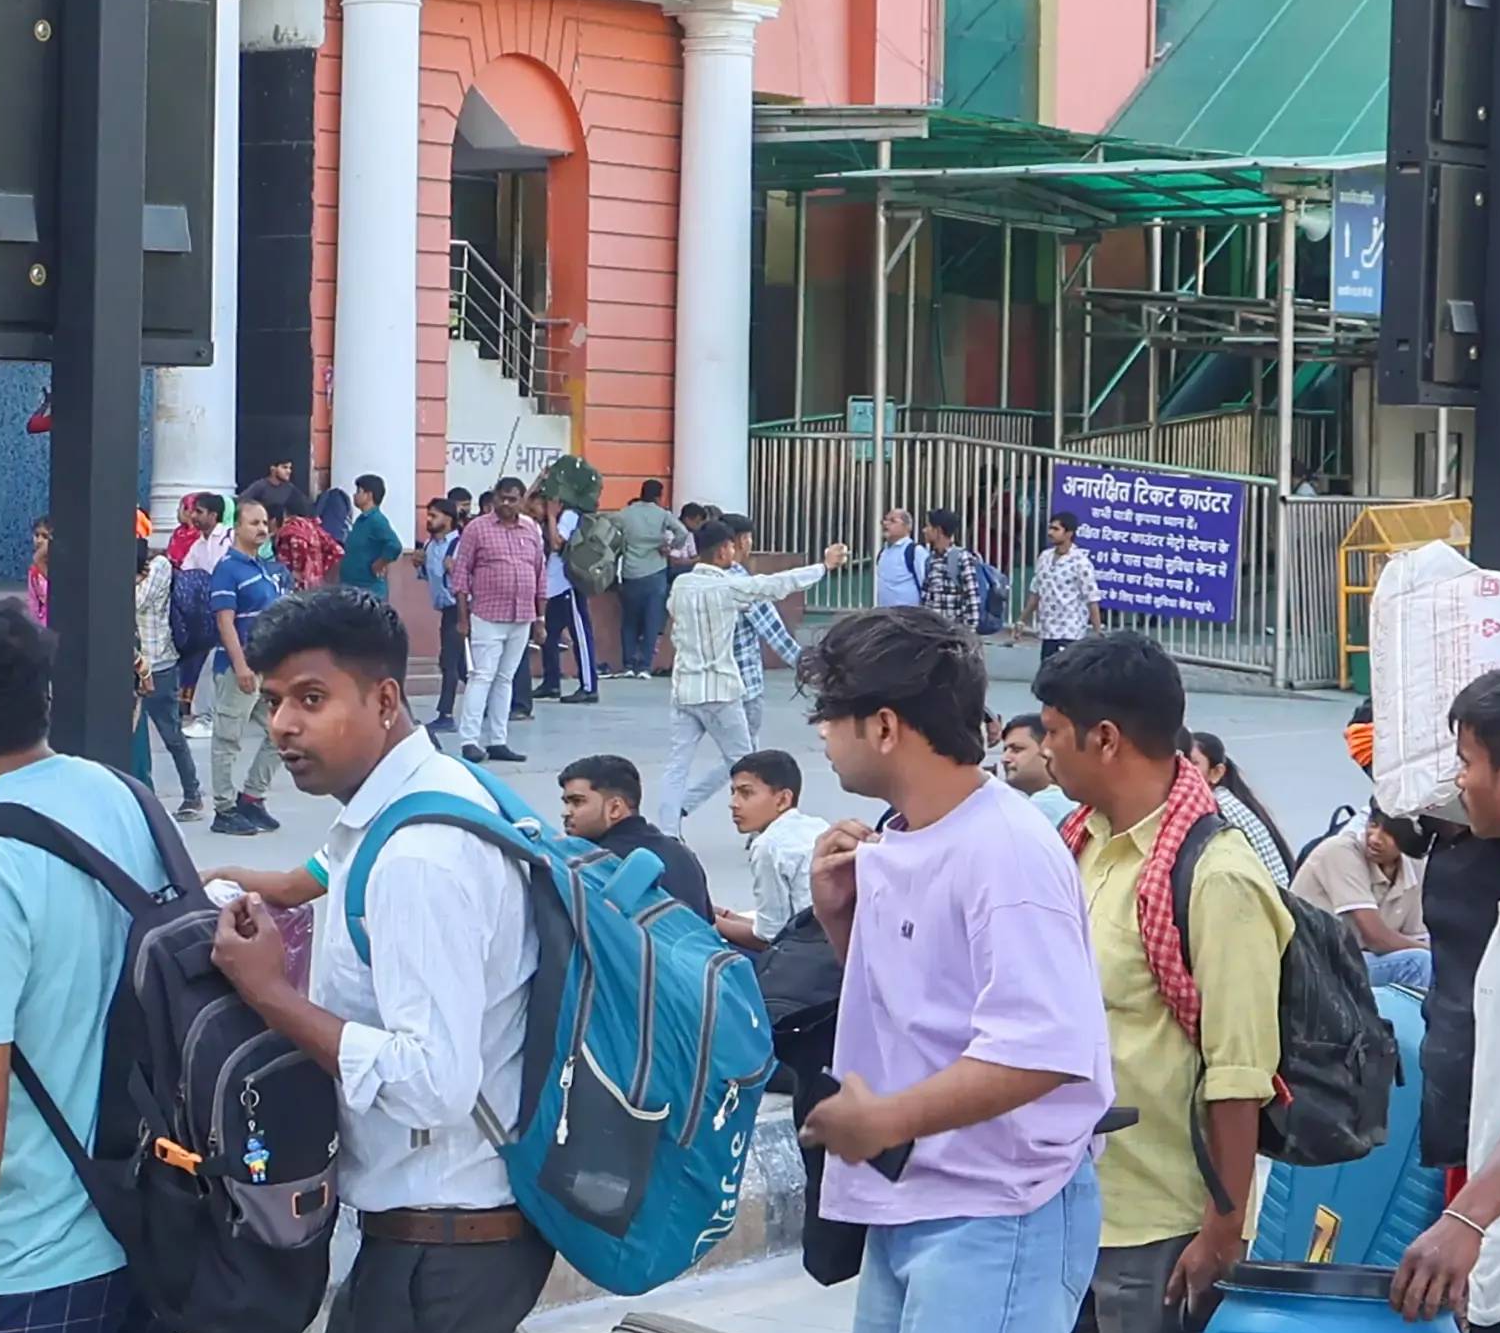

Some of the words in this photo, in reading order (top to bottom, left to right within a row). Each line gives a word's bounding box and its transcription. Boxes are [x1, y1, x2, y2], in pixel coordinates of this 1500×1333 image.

[1062, 473, 1132, 504] अनारक्षित
[1134, 477, 1177, 508] टिकट
[1178, 485, 1233, 514] काउंटर
